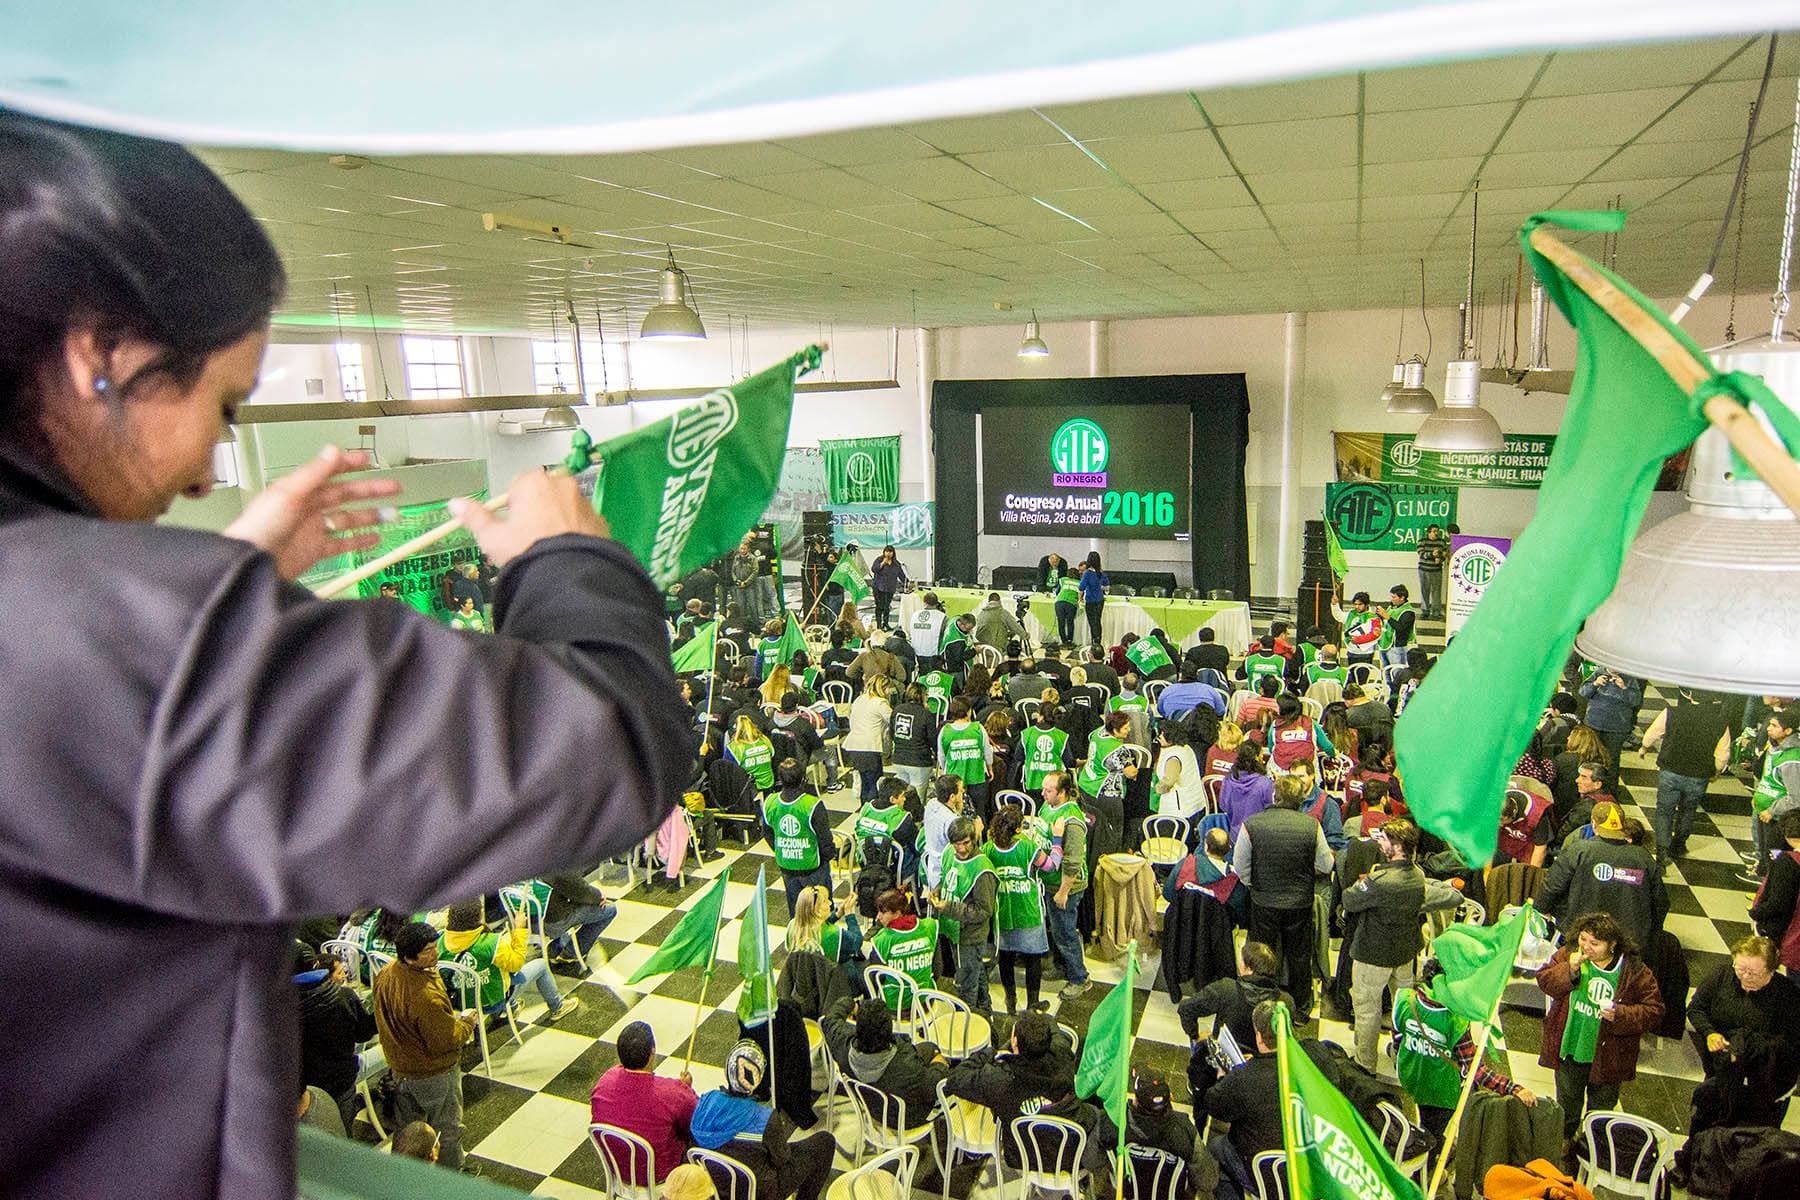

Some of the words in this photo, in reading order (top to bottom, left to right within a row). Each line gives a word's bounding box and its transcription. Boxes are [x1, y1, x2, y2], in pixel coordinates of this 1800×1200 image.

[1057, 427, 1105, 473] ATE
[1392, 441, 1422, 467] ATE
[1532, 443, 1545, 453] DE
[1440, 453, 1496, 465] INCENDIOS
[1499, 455, 1548, 467] FORESTAL
[1074, 474, 1103, 484] NEGRO
[1478, 468, 1518, 479] NAHUEL
[1521, 469, 1545, 480] HUA
[1006, 494, 1063, 511] Congreso
[1065, 495, 1102, 510] Anual
[1104, 491, 1174, 526] 2016
[1397, 500, 1449, 517] CINCO
[832, 512, 888, 525] SENASA
[1000, 510, 1018, 523] Villa
[1020, 511, 1052, 525] Regina,
[1053, 512, 1065, 524] 28
[1067, 512, 1079, 524] de
[1080, 512, 1101, 525] abril
[1336, 489, 1387, 535] ATE
[1464, 557, 1491, 583] ATE
[780, 815, 800, 836] ATE
[782, 849, 804, 859] NORTE
[1593, 863, 1613, 881] ATE
[1006, 880, 1031, 893] NEGRO
